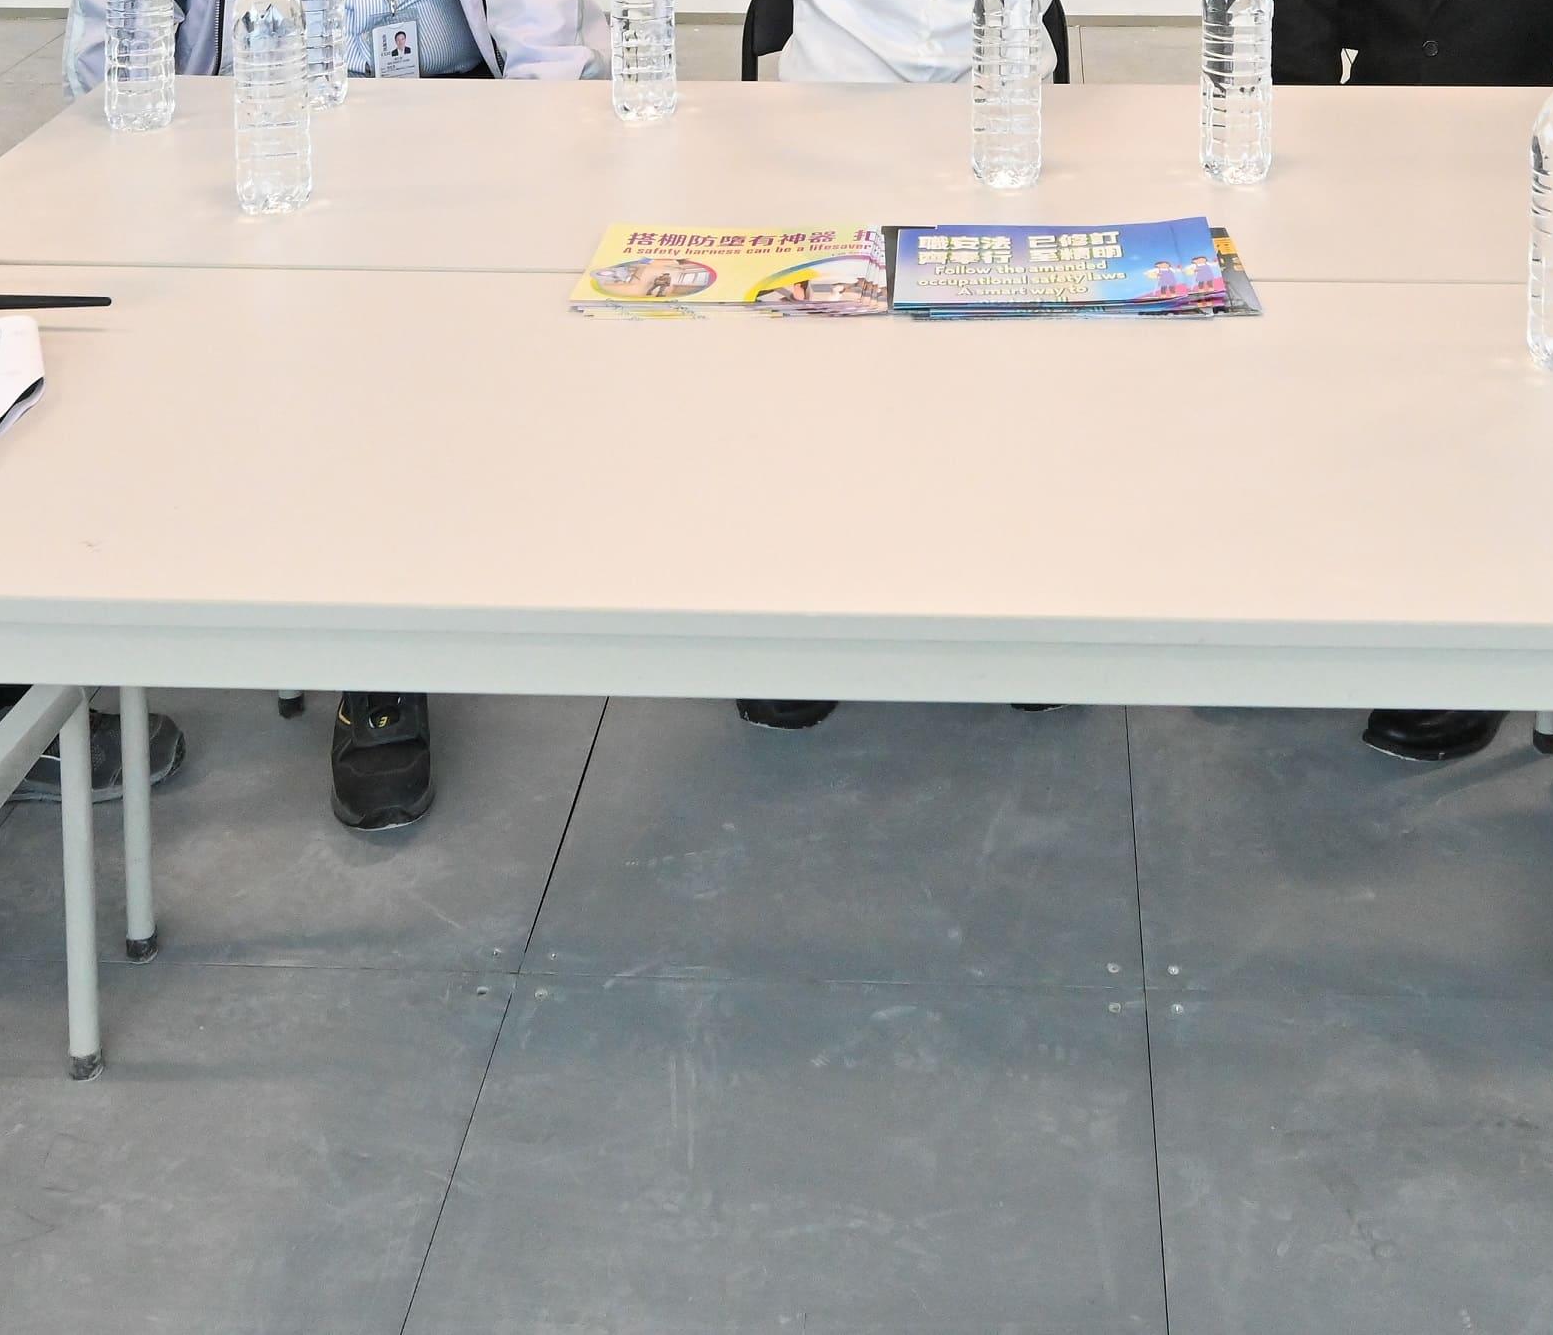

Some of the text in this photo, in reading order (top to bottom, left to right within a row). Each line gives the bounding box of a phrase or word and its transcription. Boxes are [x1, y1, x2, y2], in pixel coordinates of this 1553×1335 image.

[918, 231, 1120, 250] 職安法 已修訂
[636, 247, 680, 256] safety
[809, 244, 872, 252] lifesaver
[935, 260, 1108, 276] Follow the amended
[917, 272, 1126, 288] occupational safety laws
[957, 285, 1089, 297] A smart way to
